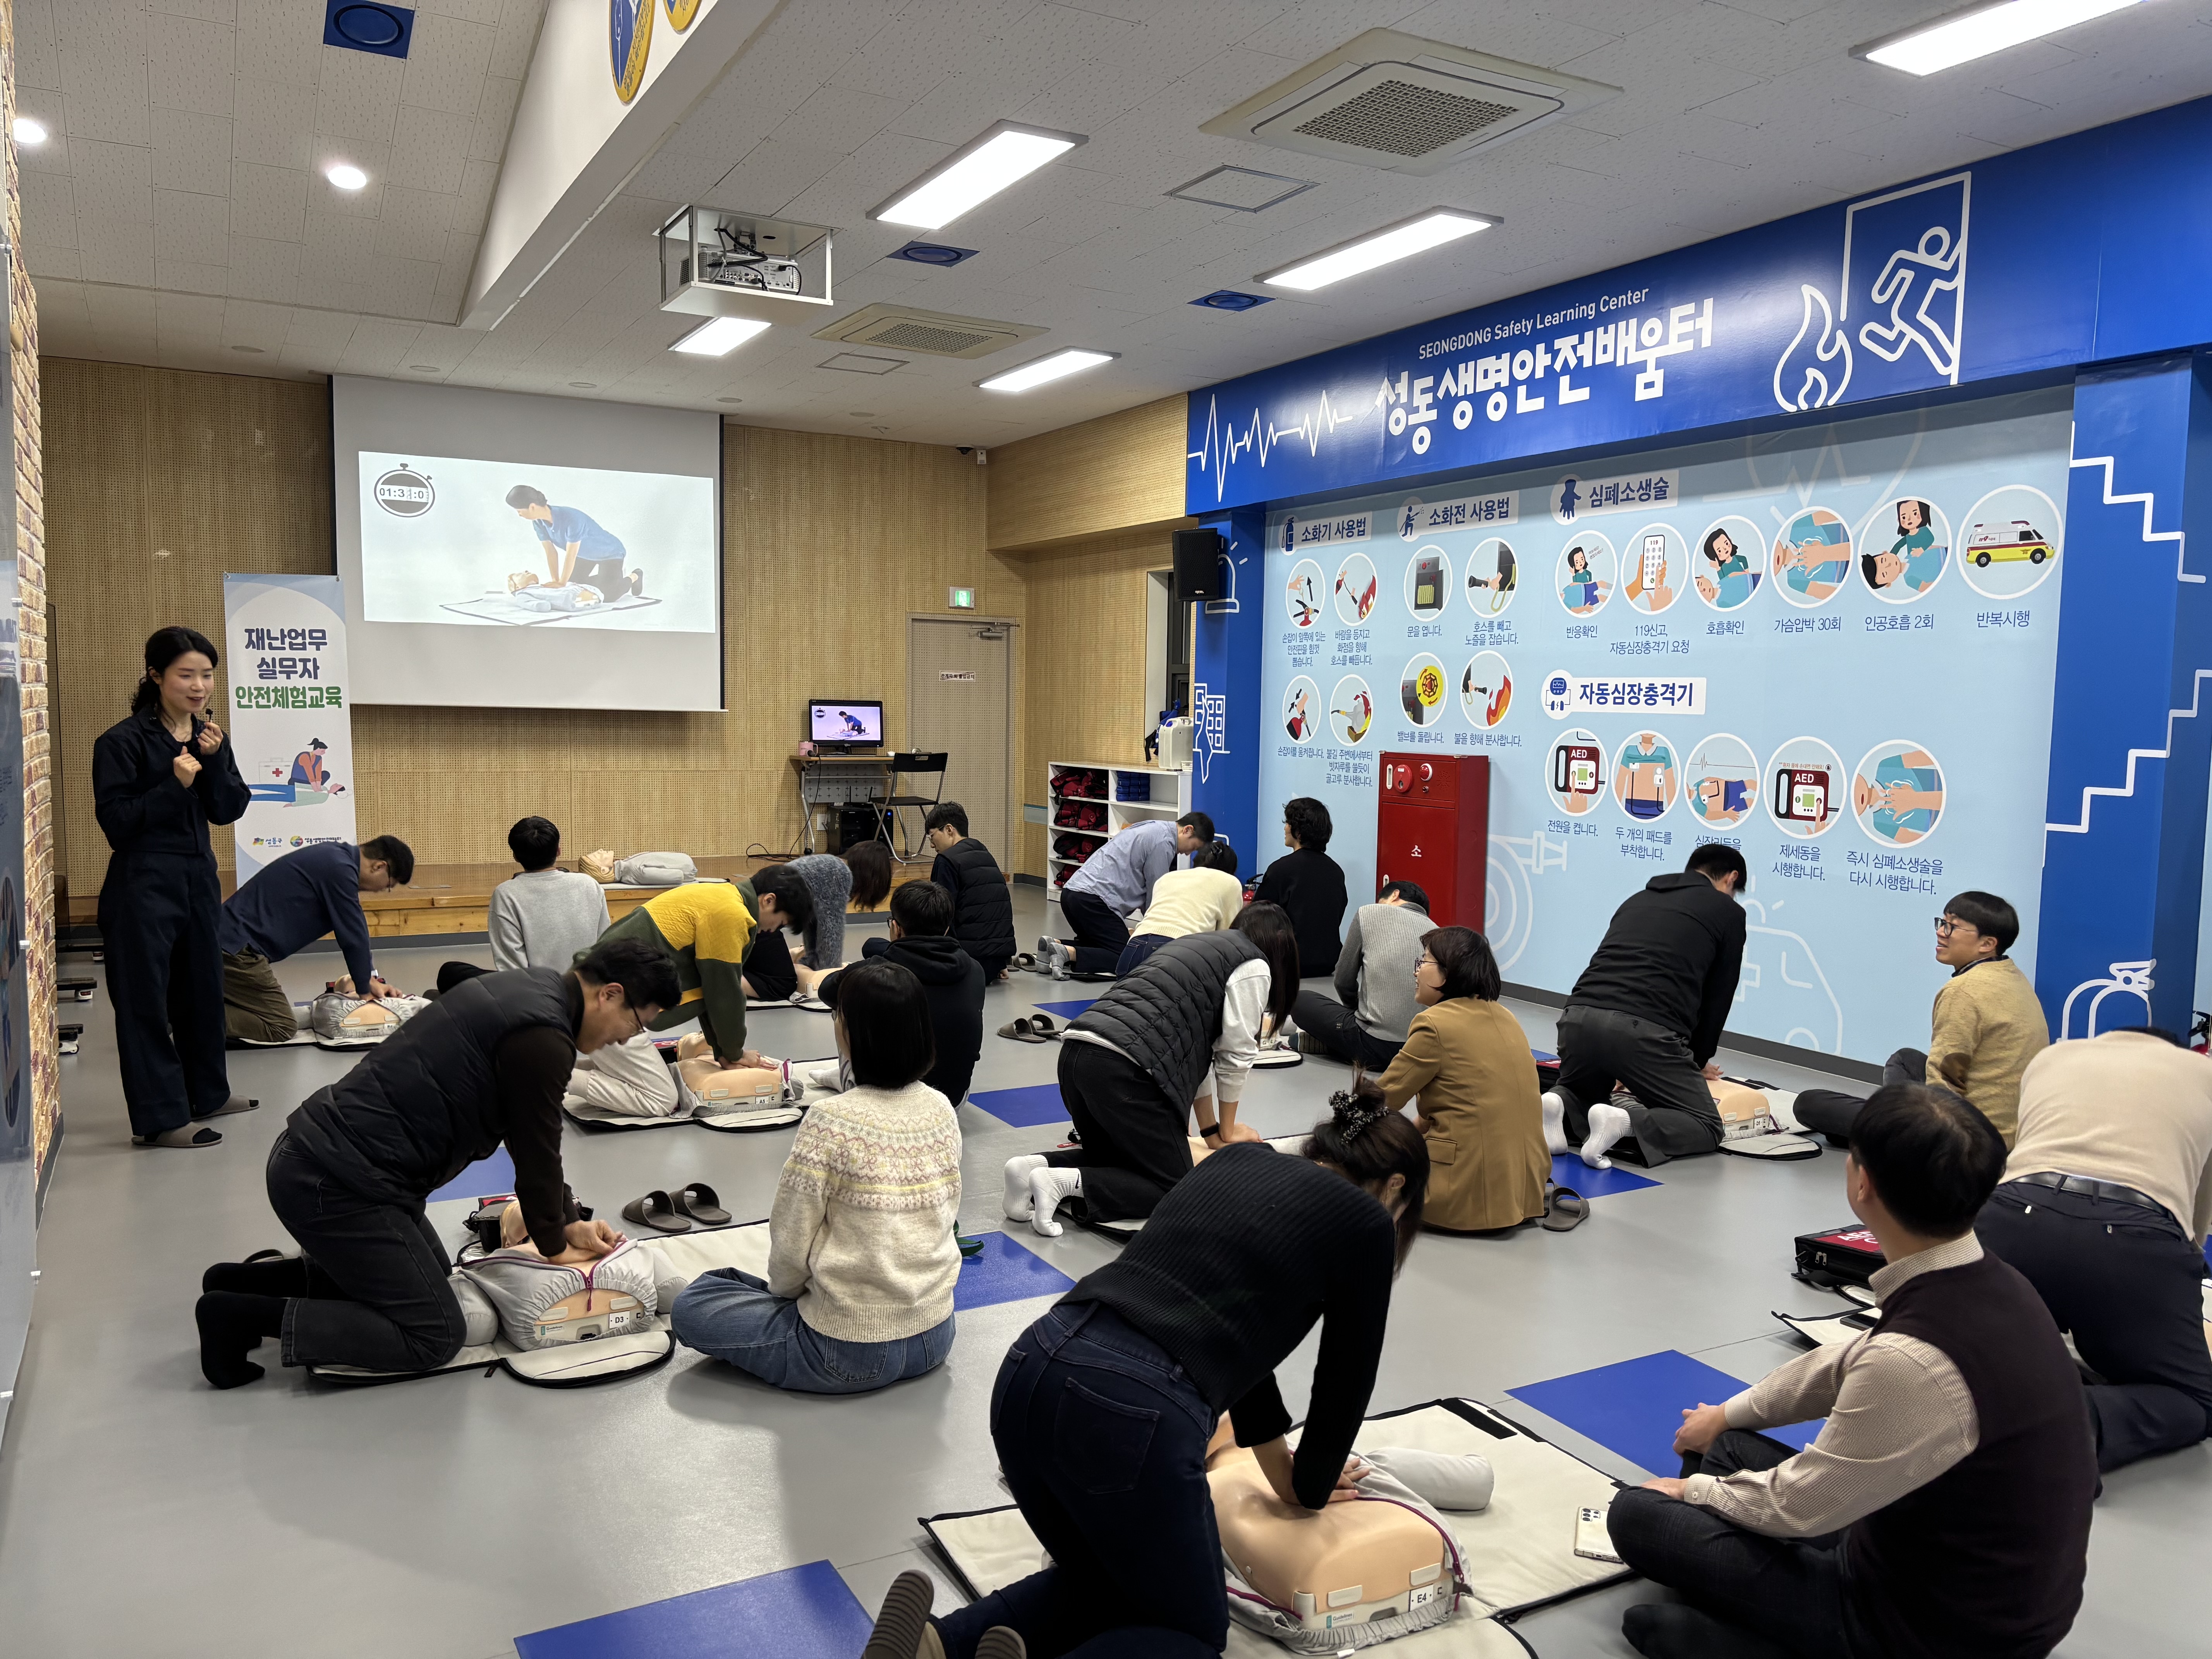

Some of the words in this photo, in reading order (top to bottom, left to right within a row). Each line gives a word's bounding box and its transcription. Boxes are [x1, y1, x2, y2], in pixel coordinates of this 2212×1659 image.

[1419, 327, 1491, 360] SEONGDONG
[1494, 316, 1533, 340] Safety
[1536, 303, 1596, 329] Learning
[1599, 287, 1649, 313] Center
[1374, 297, 1714, 455] 성동생명안전배움터
[1589, 477, 1669, 508] 심폐소생술
[1429, 503, 1466, 526] 소화전
[1470, 497, 1510, 522] 사용법
[1301, 521, 1331, 542] 소화기
[1334, 517, 1366, 539] 사용법
[1473, 621, 1494, 632] 호스를
[1497, 620, 1511, 632] 빼고
[1774, 617, 1815, 633] 가슴압박
[1818, 617, 1841, 632] 30회
[1865, 615, 1911, 631] 인공호흡
[1915, 614, 1934, 630] 2회
[1977, 610, 2030, 628] 반복시행
[1335, 629, 1352, 640] 바람을
[1353, 629, 1370, 640] 등지고
[1407, 626, 1420, 637] 문을
[1422, 625, 1442, 636] 엽니다.
[1566, 625, 1597, 638] 반응확인
[1635, 623, 1668, 637] 119신고,
[1706, 620, 1744, 635] 호흡확인
[244, 628, 328, 651] 재난업무
[1282, 633, 1297, 643] 손잡이
[1298, 632, 1314, 642] 앞쪽에
[1315, 631, 1326, 641] 있는
[1465, 634, 1486, 646] 노즐을
[1489, 632, 1518, 645] 잡습니다.
[1288, 644, 1307, 655] 안전판을
[1309, 644, 1319, 654] 힘껏
[1337, 642, 1354, 653] 화점을
[1355, 642, 1367, 652] 향해
[1610, 640, 1668, 654] 자동심장충격기
[1671, 640, 1689, 654] 요청
[1292, 656, 1313, 667] 뽑습니다.
[1330, 655, 1347, 666] 호스를
[1349, 654, 1372, 666] 빼듭니다.
[257, 657, 320, 680] 실무자
[235, 686, 342, 709] 안전체험교육
[1580, 682, 1693, 706] 자동심장충격기
[1398, 731, 1415, 742] 밸브를
[1418, 731, 1444, 744] 돌립니다.
[1454, 733, 1468, 745] 불을
[1470, 733, 1484, 745] 향해
[1485, 734, 1522, 747] 분사합니다.
[1278, 746, 1297, 757] 손잡이를
[1326, 749, 1338, 759] 불길
[1339, 749, 1373, 761] 주변에서부터
[1571, 749, 1587, 758] AED
[1329, 761, 1351, 773] 빗자루를
[1352, 763, 1369, 774] 쓸듯이
[1326, 773, 1342, 784] 골고루
[1343, 775, 1373, 787] 분사합니다.
[1794, 773, 1814, 783] AED
[1547, 820, 1571, 834] 전원을
[1573, 823, 1598, 837] 켭니다.
[1615, 827, 1624, 838] 두
[1627, 828, 1644, 842] 개의
[1646, 830, 1673, 845] 패드를
[1411, 845, 1422, 857] 소
[1621, 844, 1664, 861] 부착합니다.
[1779, 844, 1821, 862] 제세동을
[1846, 851, 1869, 867] 즉시
[1872, 854, 1943, 875] 심폐소생술을
[1772, 862, 1825, 881] 시행합니다.
[1850, 871, 1872, 887] 다시
[1875, 874, 1936, 895] 시행합니다.
[1417, 1593, 1427, 1603] E4
